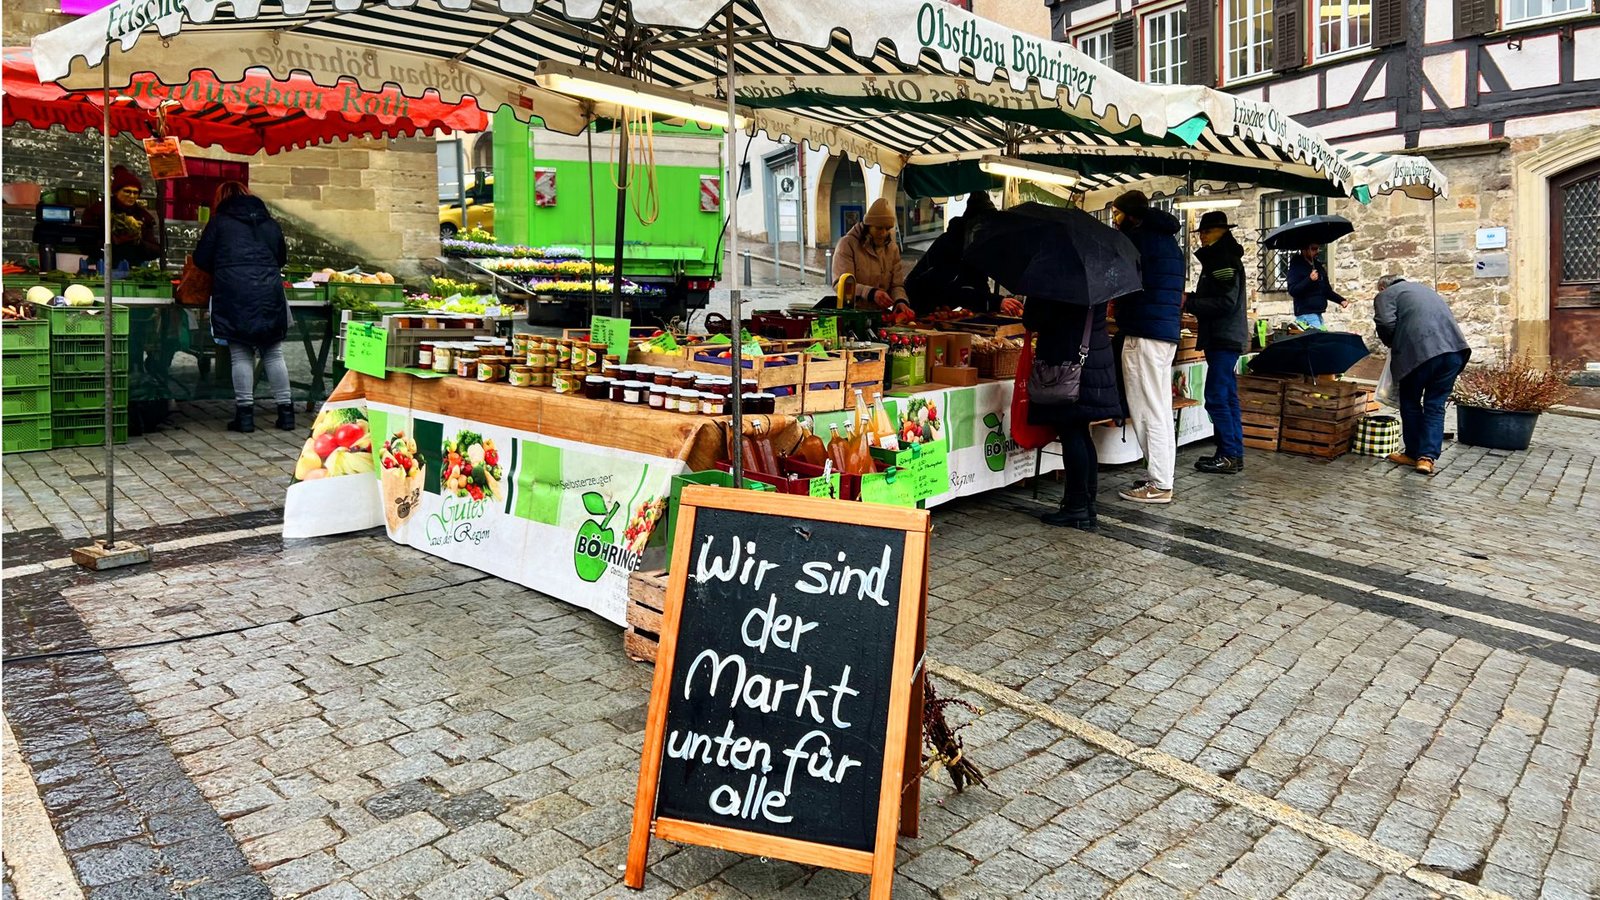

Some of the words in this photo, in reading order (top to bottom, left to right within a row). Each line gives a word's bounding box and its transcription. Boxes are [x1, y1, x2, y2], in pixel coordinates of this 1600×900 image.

[917, 2, 1006, 68] Obstbau
[340, 84, 411, 119] Roth
[426, 495, 488, 534] Gutes
[454, 522, 490, 545] Region
[695, 535, 780, 591] Wir
[795, 544, 890, 607] sind
[741, 593, 819, 653] der
[685, 649, 860, 728] Markt
[667, 720, 773, 774] unten
[783, 730, 862, 796] für
[708, 773, 794, 824] alle
